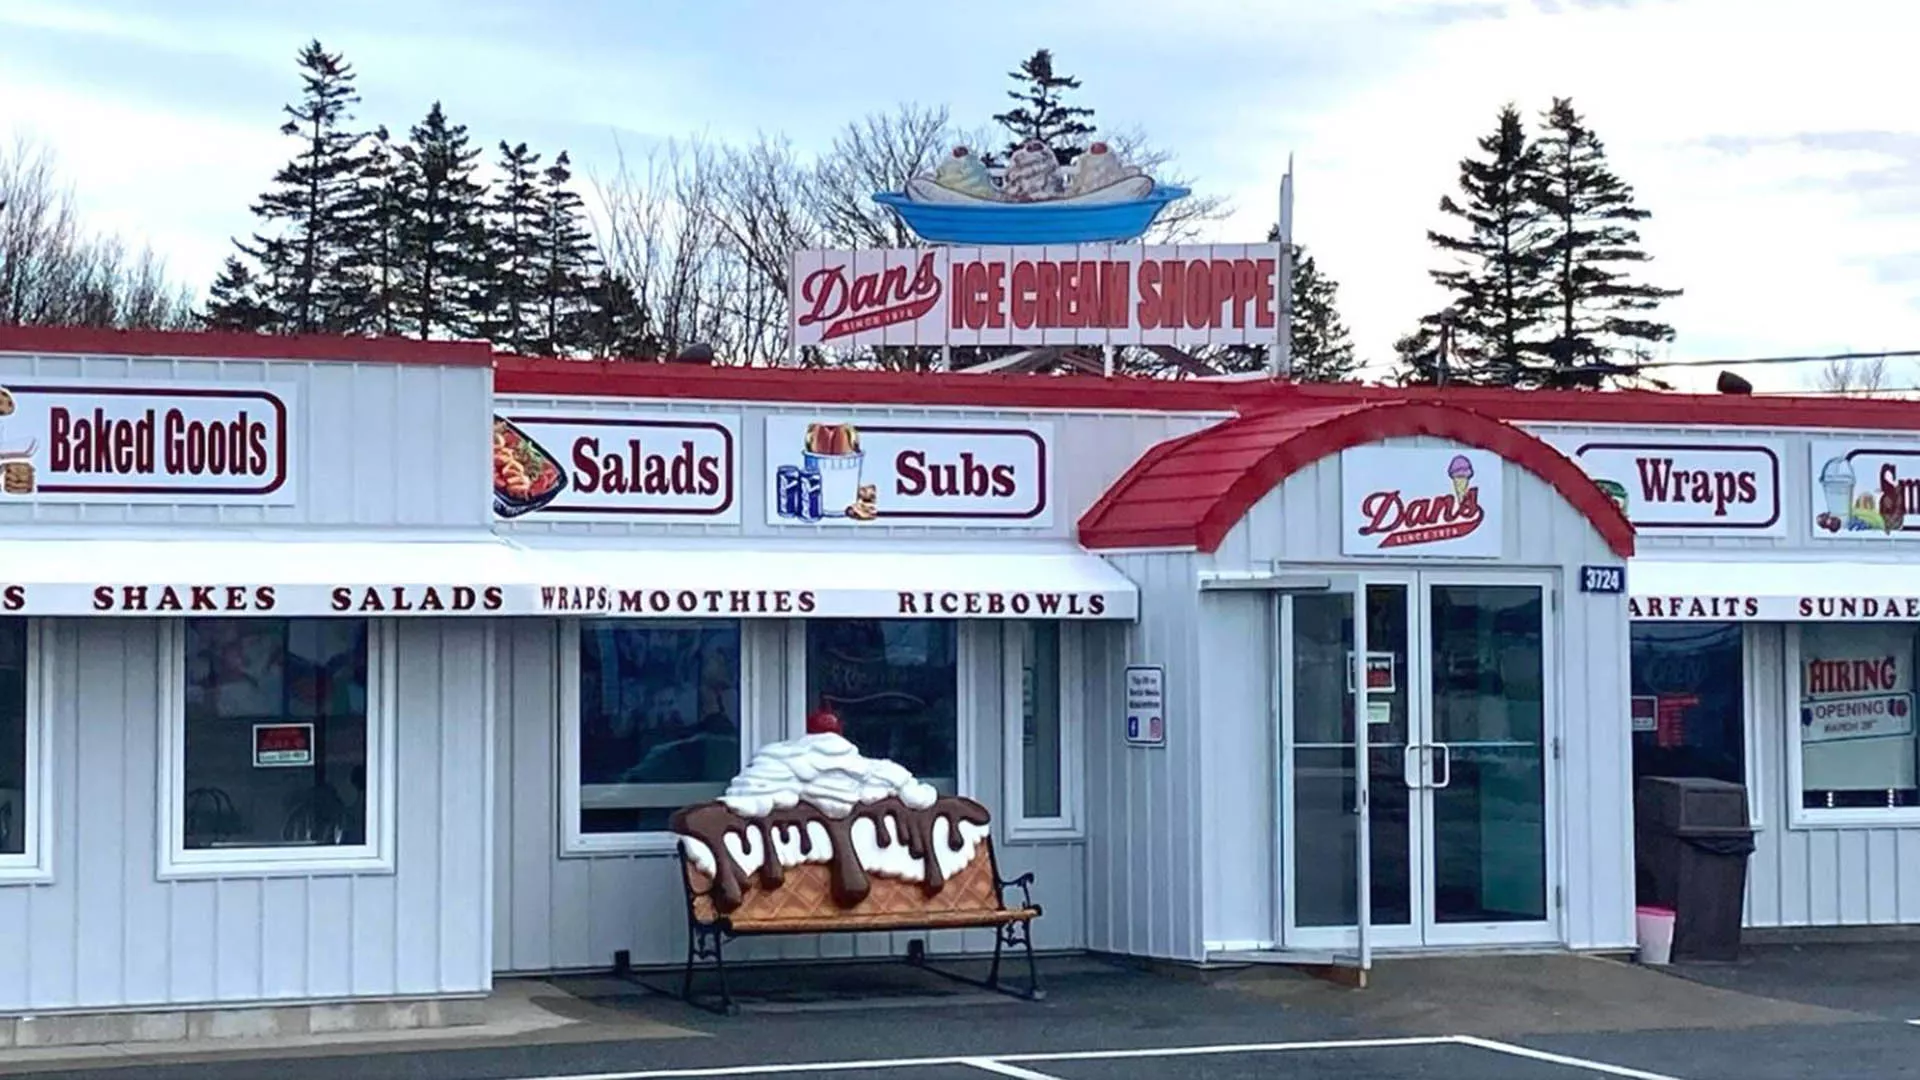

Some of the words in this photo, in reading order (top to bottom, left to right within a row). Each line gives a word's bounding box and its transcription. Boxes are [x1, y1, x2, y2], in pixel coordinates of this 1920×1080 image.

[798, 252, 942, 325] Dans
[952, 261, 1005, 329] ICE
[1011, 260, 1130, 330] CREAM
[1137, 259, 1276, 330] SHOPPE
[841, 315, 881, 331] SINCE
[50, 407, 155, 474] Baked
[164, 408, 267, 475] Goods
[572, 436, 719, 496] Salads
[896, 450, 1016, 497] Subs
[1636, 458, 1757, 516] Wraps
[1358, 486, 1484, 535] Dans
[1396, 530, 1429, 543] SINCE
[3, 585, 25, 610] S
[93, 586, 276, 610] SHAKES
[331, 587, 503, 611] SALADS
[608, 590, 815, 612] MOOTHIES
[898, 592, 1105, 614] RICEBOWLS
[1586, 568, 1619, 590] 3724
[1629, 597, 1759, 617] ARFAITS
[1799, 597, 1920, 617] SUNDAE
[1809, 655, 1897, 693] HIRING
[1815, 700, 1885, 719] OPENING
